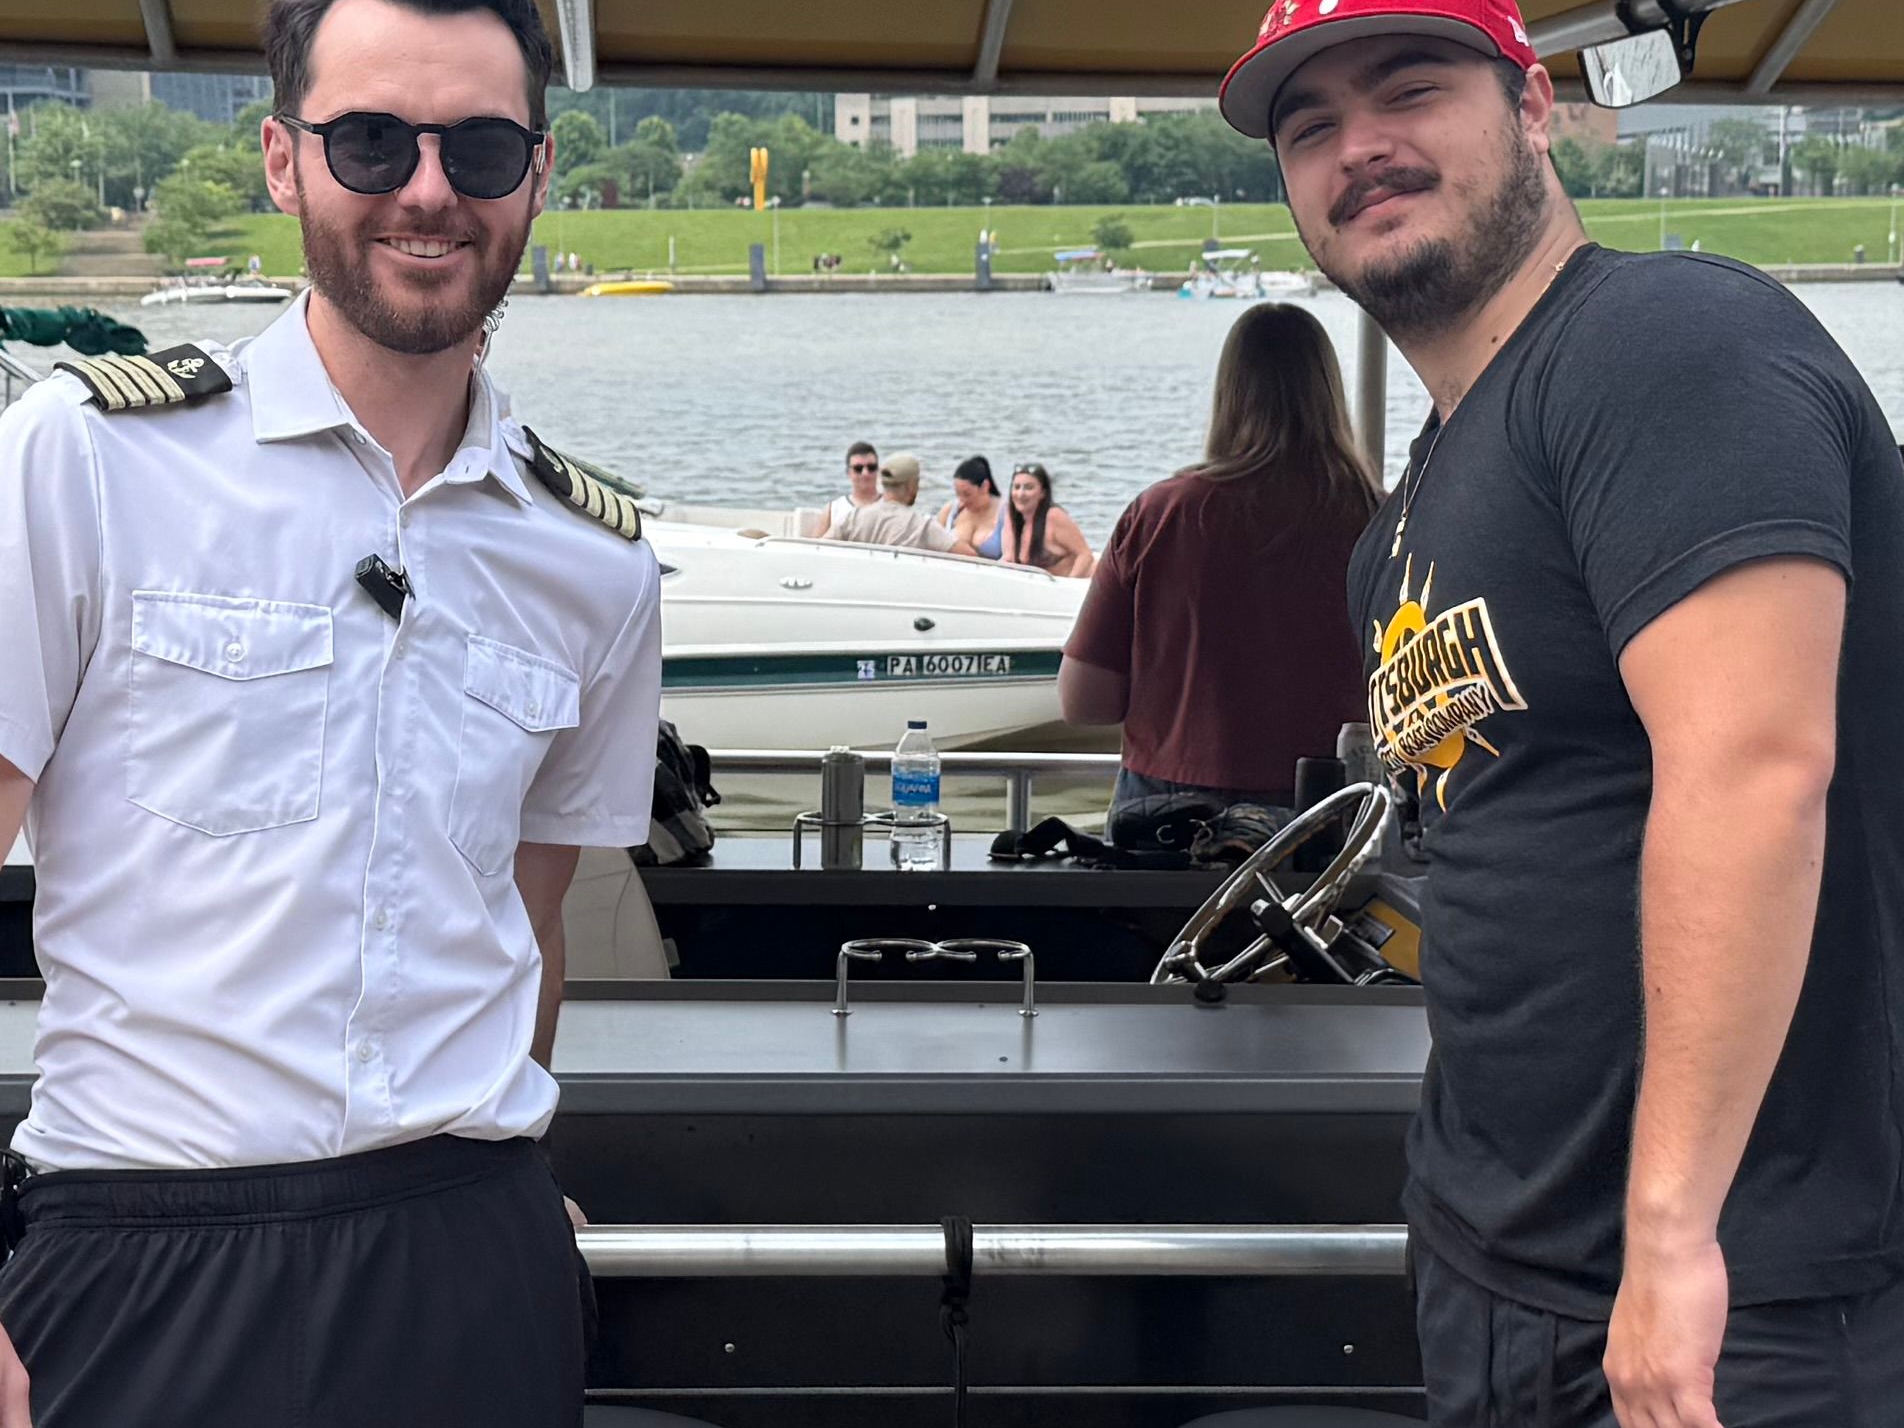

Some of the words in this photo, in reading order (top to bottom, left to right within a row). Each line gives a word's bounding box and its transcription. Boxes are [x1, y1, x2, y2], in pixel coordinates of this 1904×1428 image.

[889, 657, 914, 673] PA
[925, 655, 975, 673] 6007
[983, 656, 1007, 673] EA
